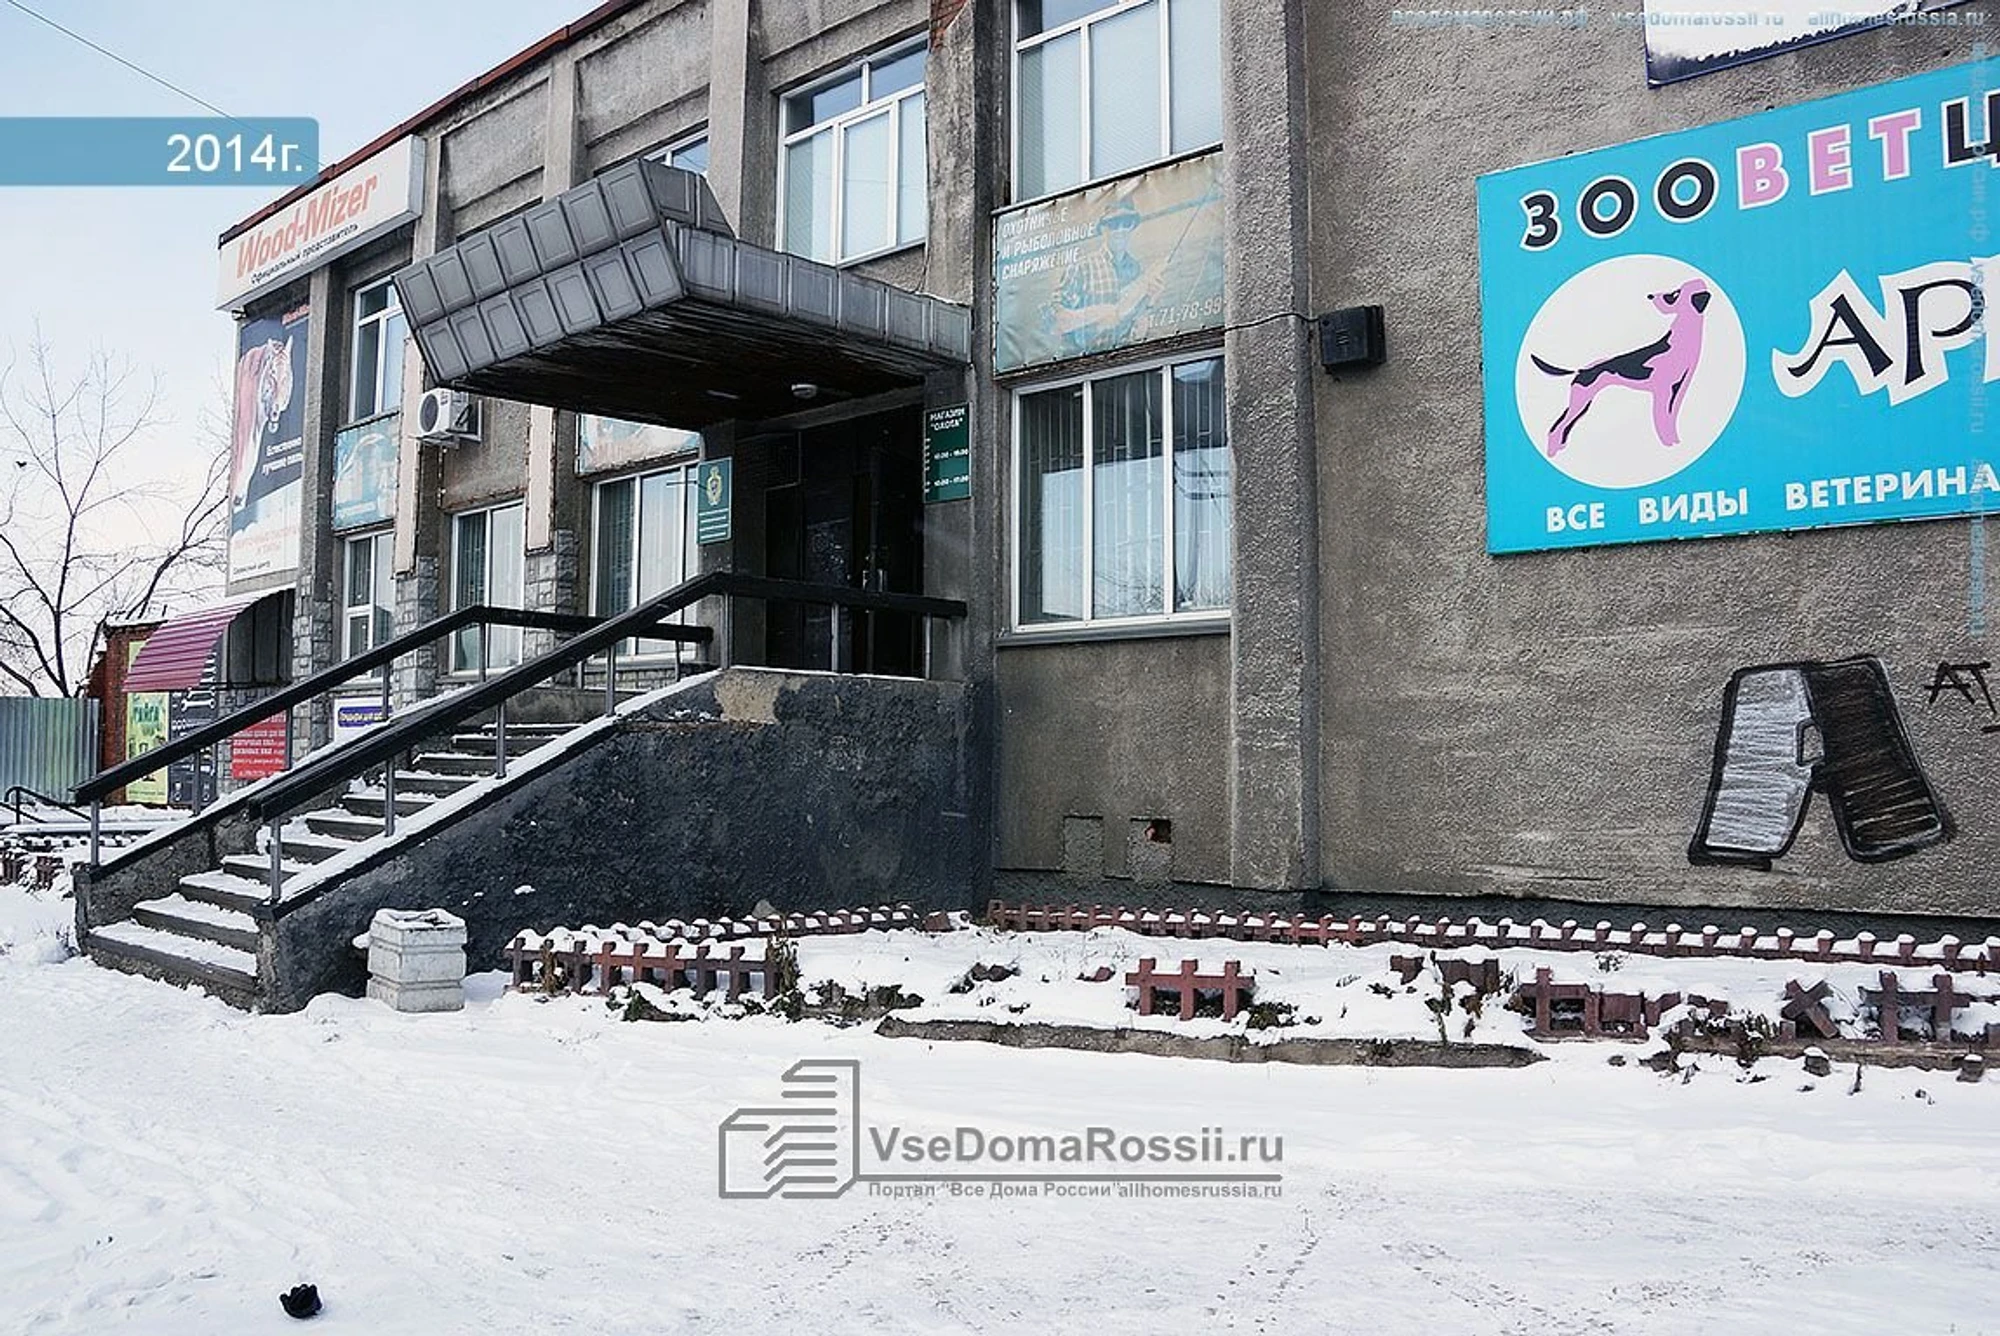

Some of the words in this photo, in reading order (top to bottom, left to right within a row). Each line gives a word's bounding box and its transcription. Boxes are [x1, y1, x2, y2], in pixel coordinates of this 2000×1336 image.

[236, 174, 378, 280] Wood-Mizer
[1546, 503, 1605, 533] ВСЕ
[1638, 488, 1749, 526] ВИДЫ
[1785, 463, 2000, 512] ВЕТЕРИНА
